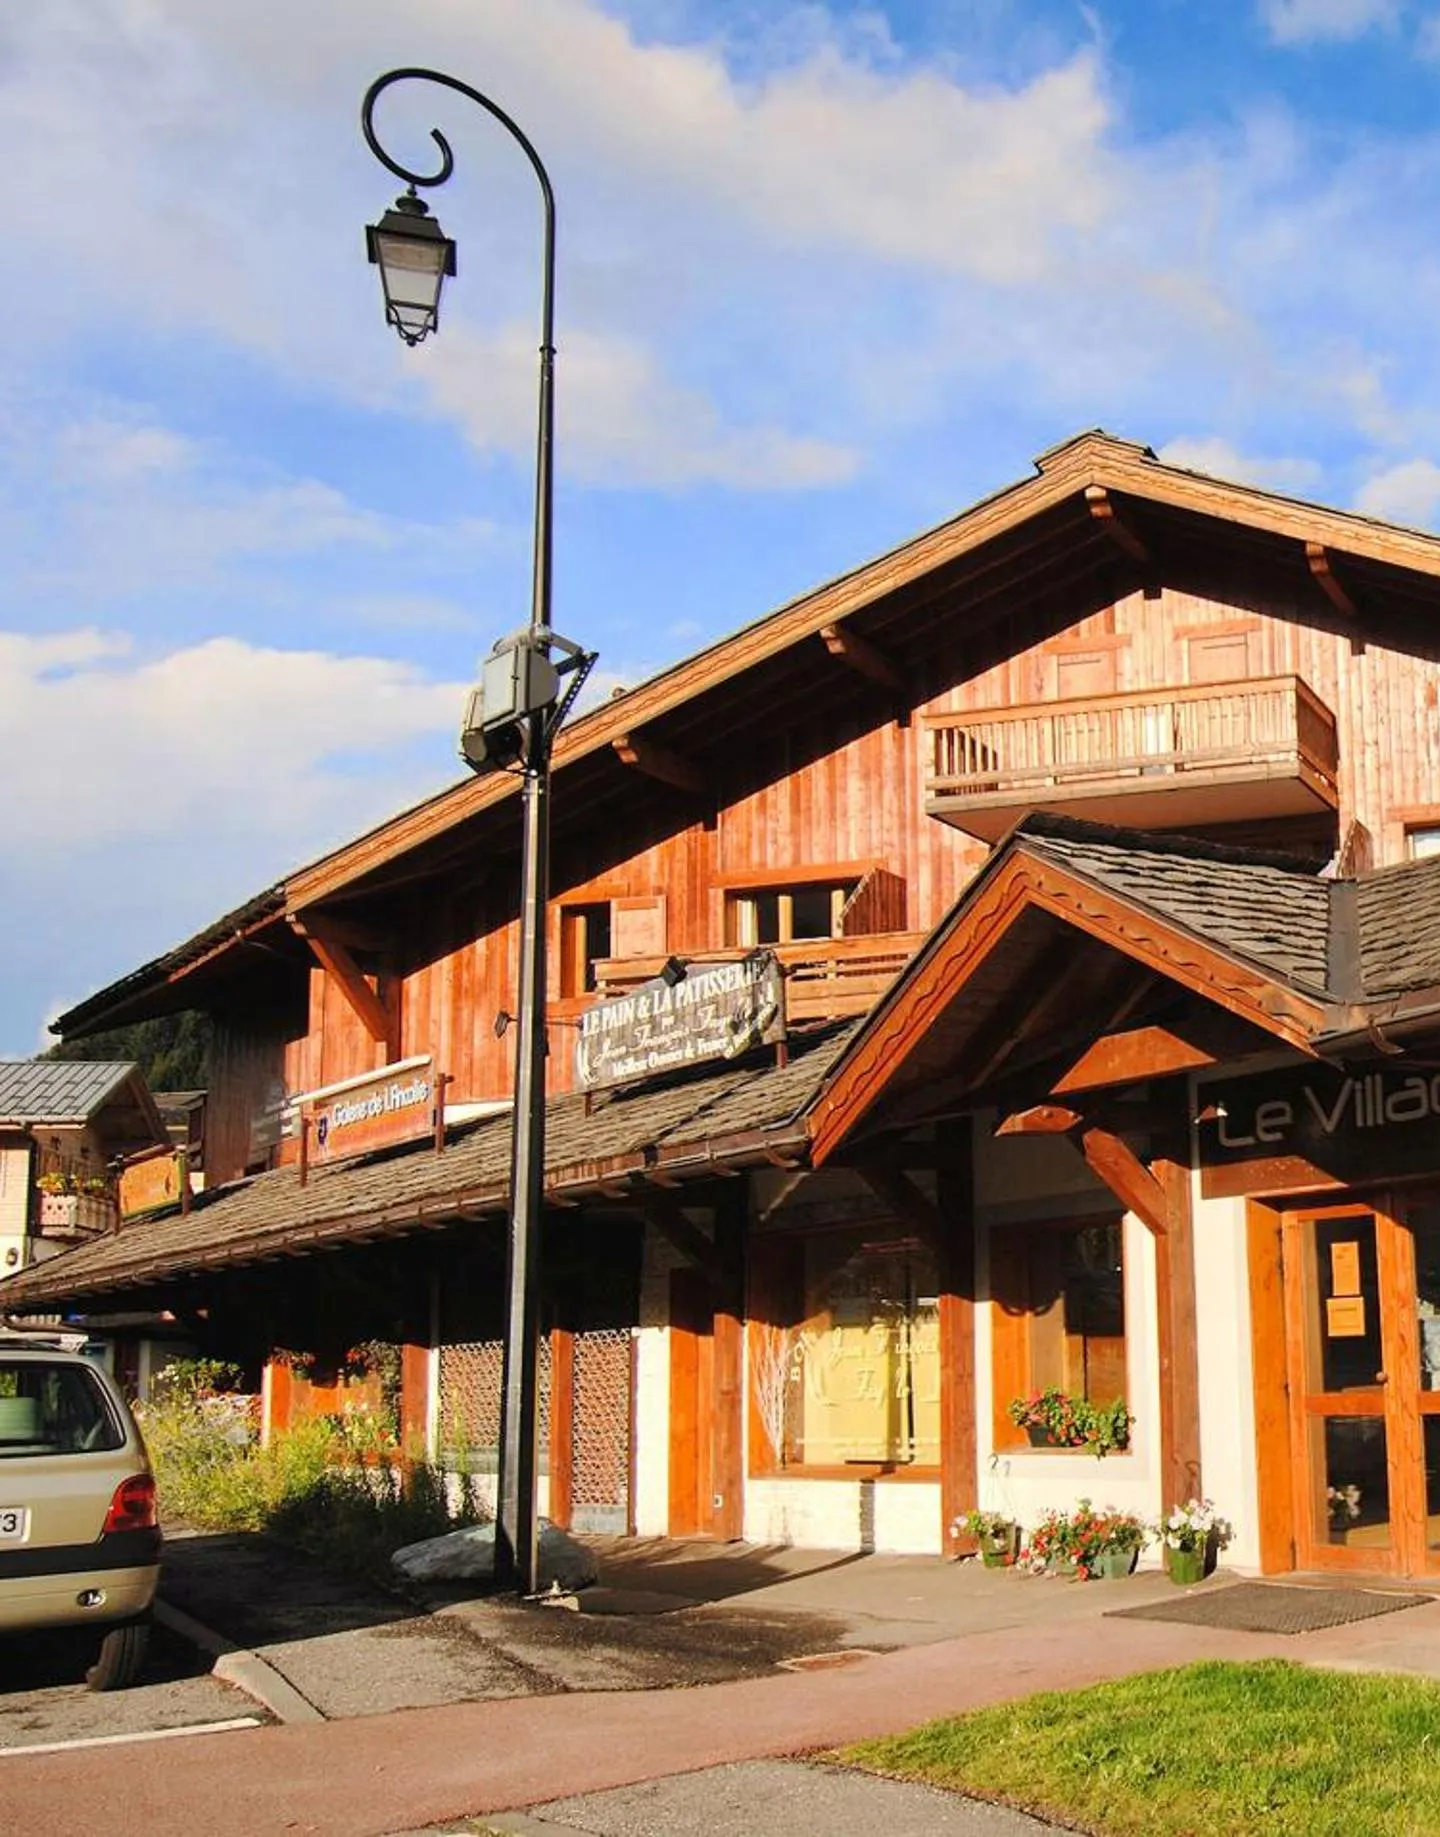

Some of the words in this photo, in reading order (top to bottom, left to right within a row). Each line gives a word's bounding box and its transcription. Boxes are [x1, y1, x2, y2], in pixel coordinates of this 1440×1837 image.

[583, 1009, 600, 1037] LE
[602, 999, 636, 1031] PAIN
[635, 996, 650, 1018] &
[653, 988, 674, 1015] LA
[674, 960, 765, 1009] PATISSERIE
[1218, 1099, 1294, 1147] Le
[0, 1513, 17, 1532] 3
